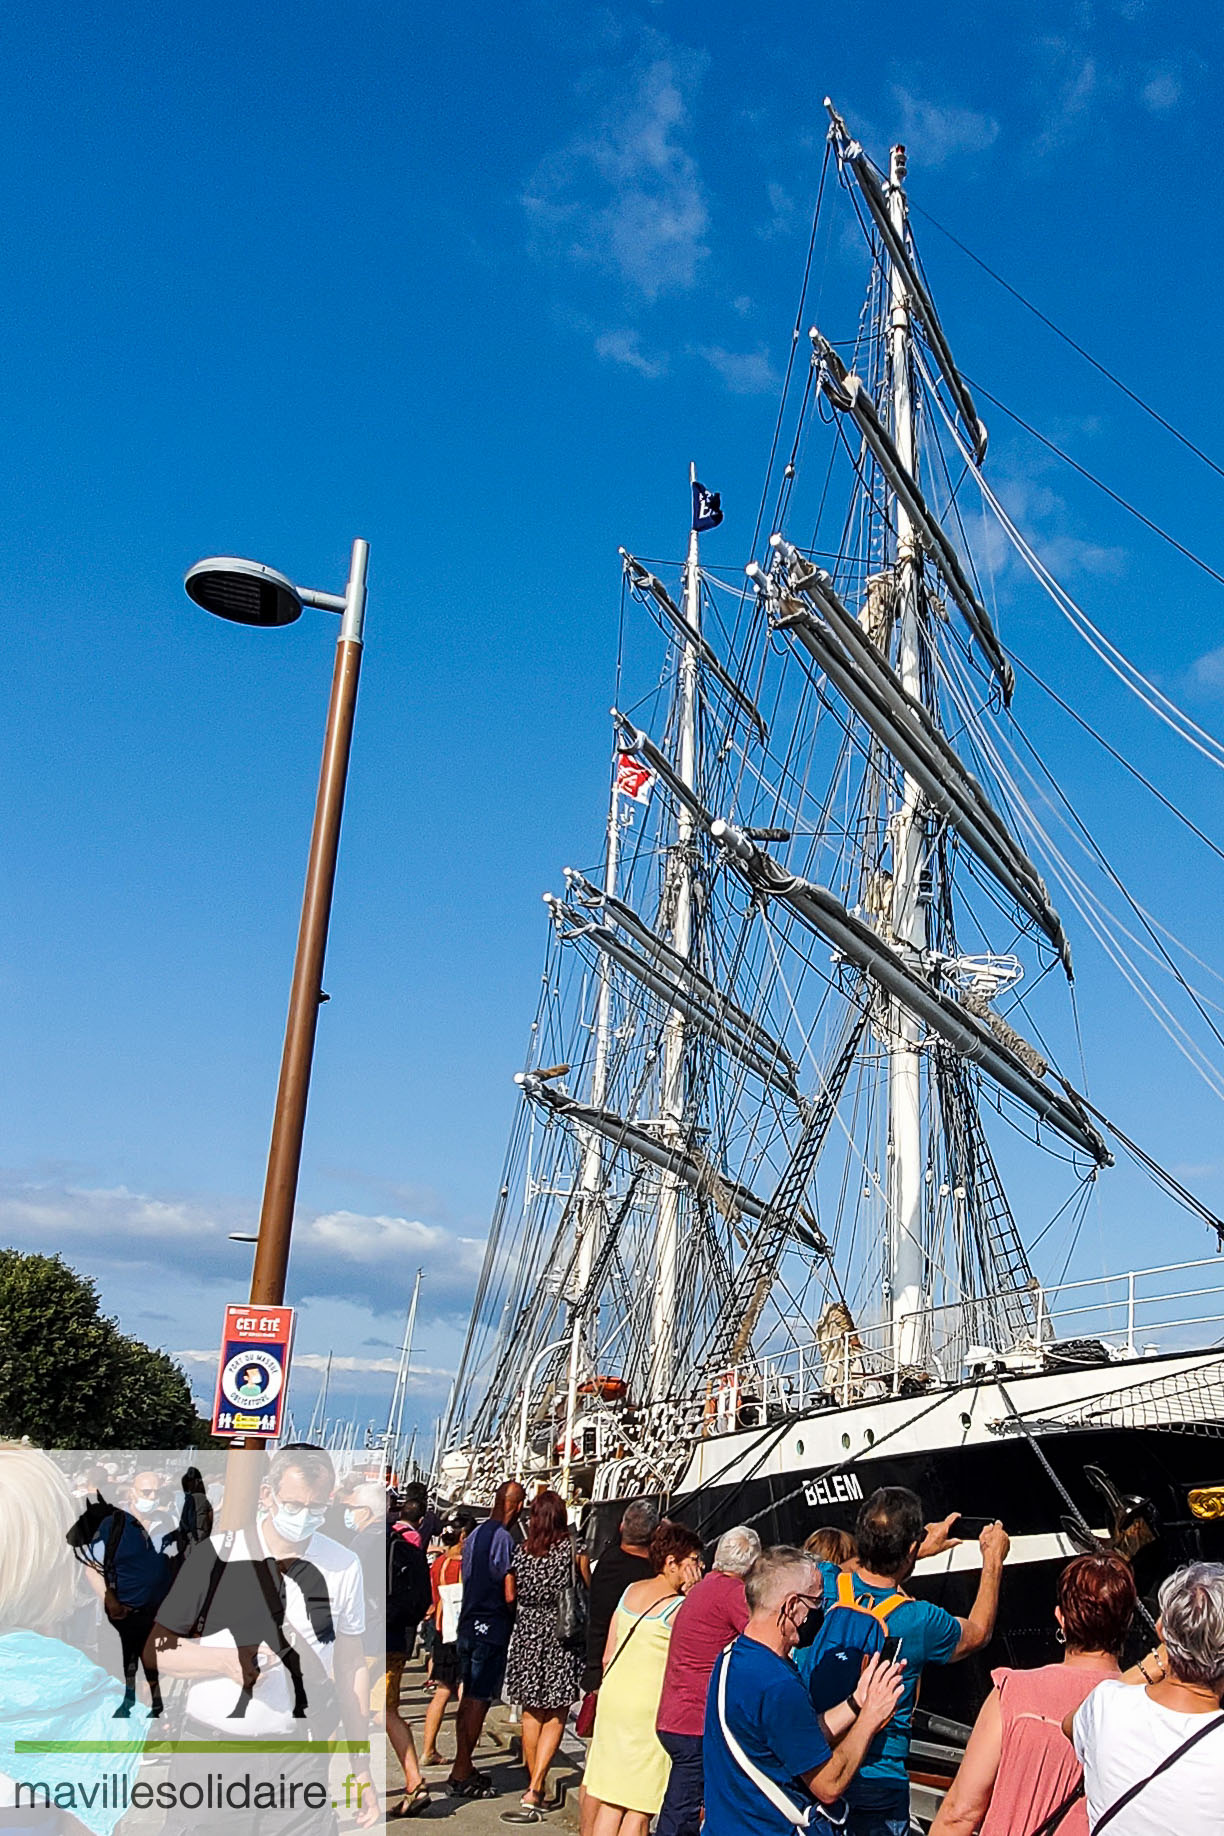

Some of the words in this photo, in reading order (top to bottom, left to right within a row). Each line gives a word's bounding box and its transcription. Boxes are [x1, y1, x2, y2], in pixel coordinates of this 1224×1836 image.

[236, 1317, 257, 1331] CET
[259, 1316, 281, 1332] ÉTÉ
[228, 1356, 244, 1373] PORT
[244, 1353, 254, 1361] DU
[802, 1473, 864, 1507] BELEM
